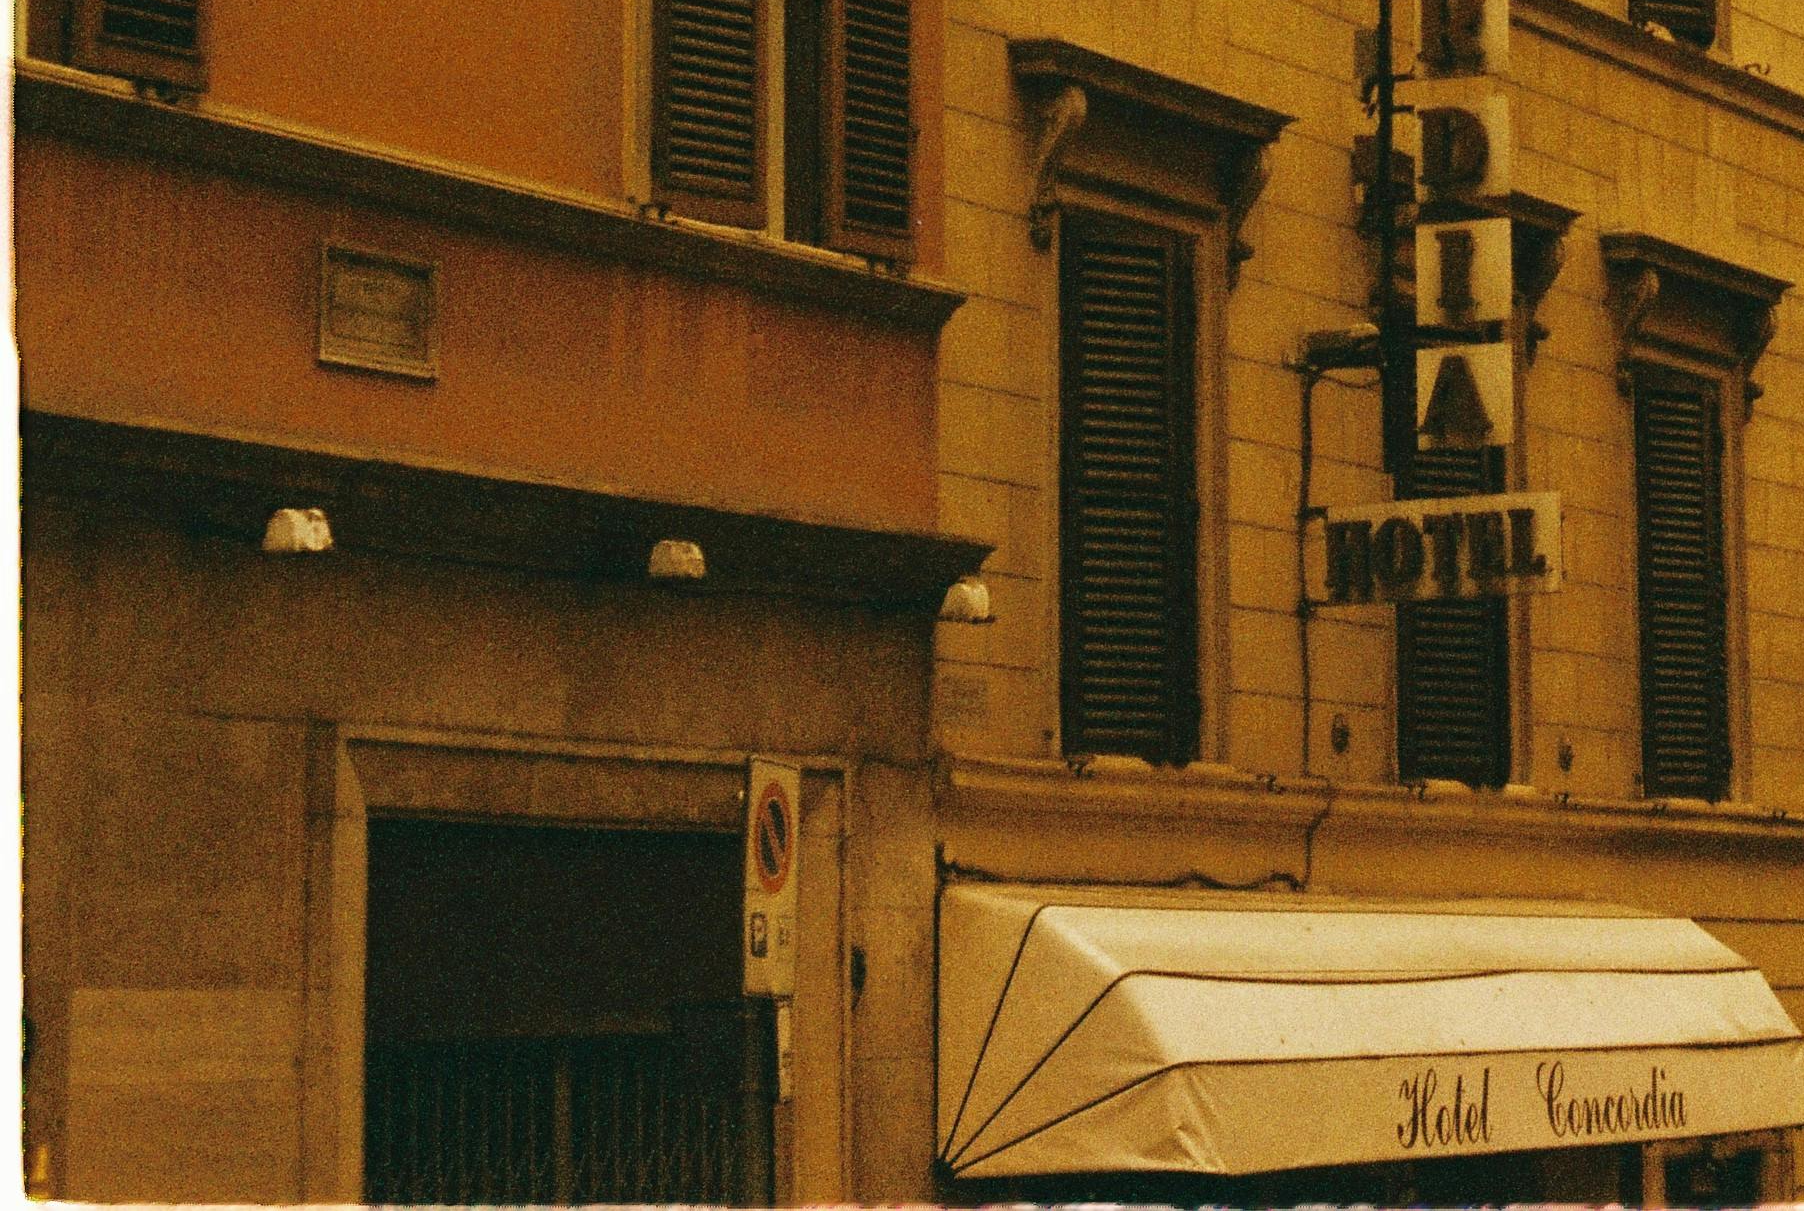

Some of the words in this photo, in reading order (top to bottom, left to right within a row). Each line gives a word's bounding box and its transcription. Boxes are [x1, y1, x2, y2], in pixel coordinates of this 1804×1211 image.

[1324, 506, 1548, 603] HOTEL
[1397, 1067, 1492, 1149] Hotel
[1536, 1060, 1688, 1139] Concordia
